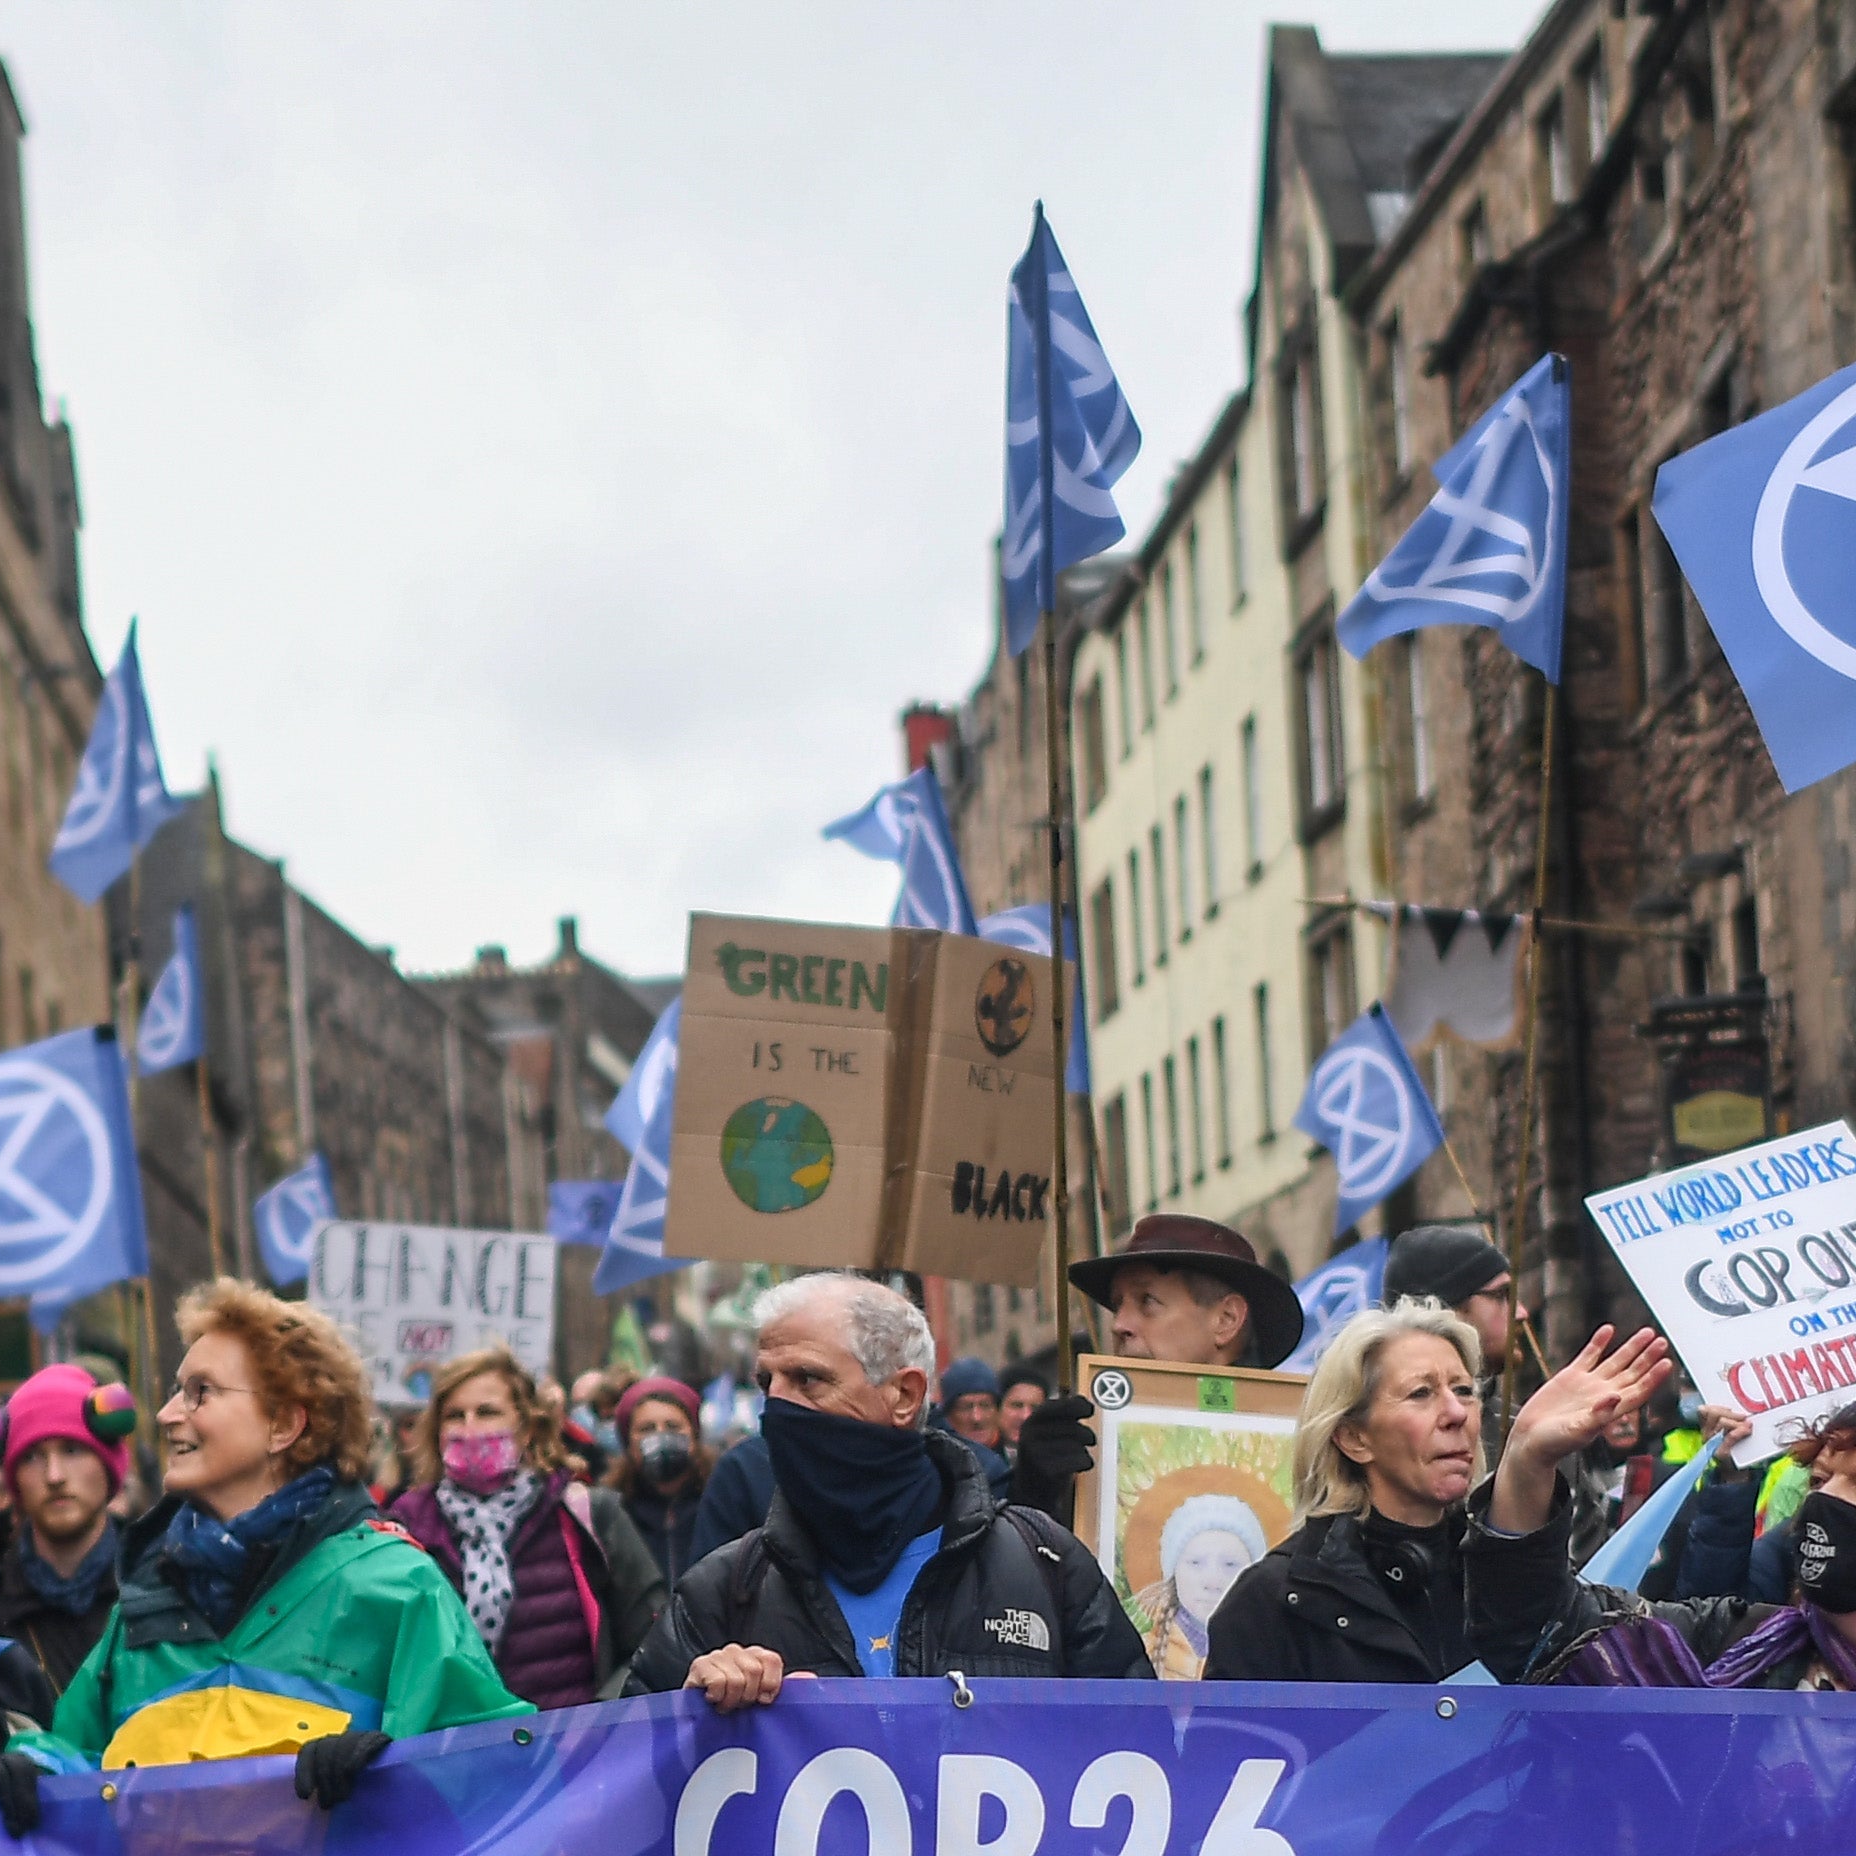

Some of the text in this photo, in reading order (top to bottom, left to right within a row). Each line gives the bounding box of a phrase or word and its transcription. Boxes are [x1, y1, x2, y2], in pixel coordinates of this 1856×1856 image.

[718, 941, 890, 1013] GREEN
[751, 1040, 860, 1075] IS THE
[967, 1063, 1018, 1095] NEW
[951, 1160, 1050, 1222] BLACK
[1598, 1202, 1662, 1244] TELL
[1652, 1175, 1743, 1226] WORLD
[1715, 1208, 1795, 1245] NOT TO
[314, 1222, 546, 1320] CHANGE
[1682, 1245, 1800, 1318] COP
[1788, 1313, 1827, 1338] ON
[984, 1618, 1030, 1636] NORTH
[1004, 1608, 1031, 1622] THE
[997, 1630, 1031, 1646] FACE
